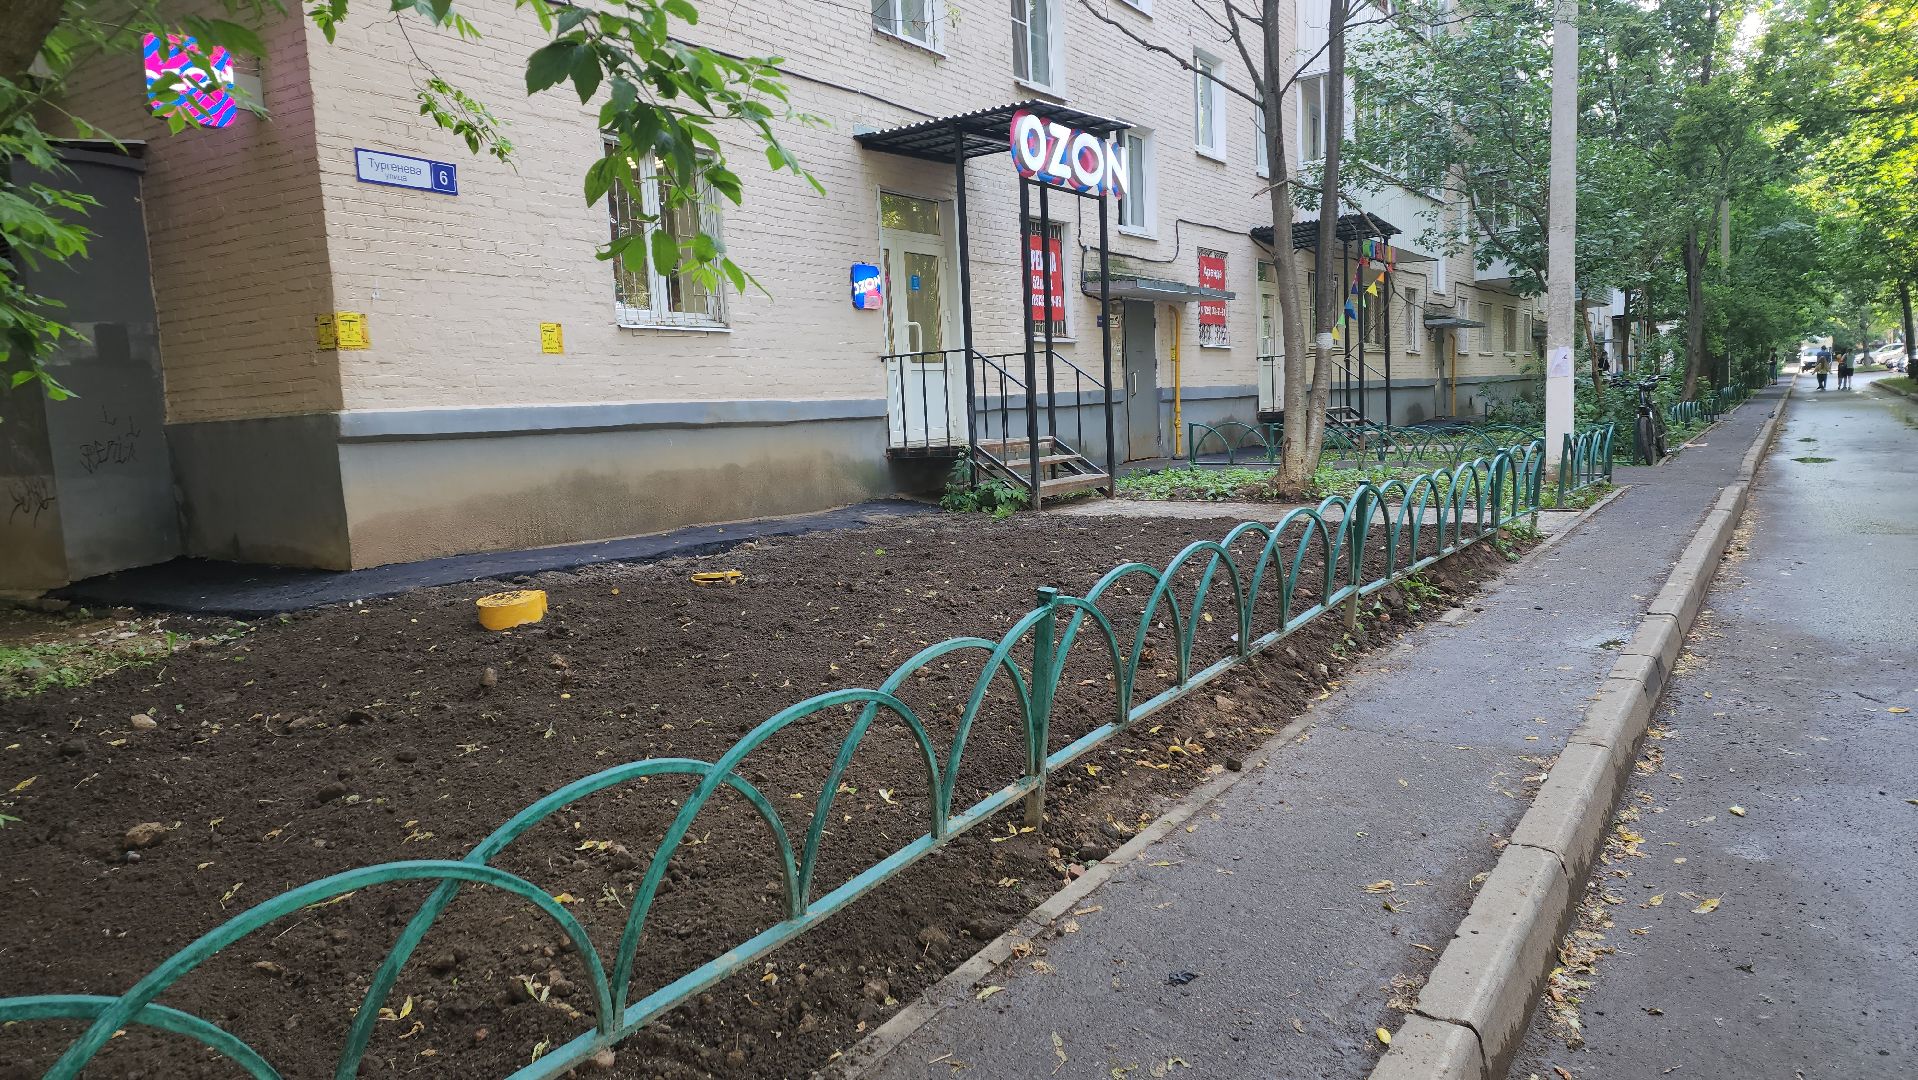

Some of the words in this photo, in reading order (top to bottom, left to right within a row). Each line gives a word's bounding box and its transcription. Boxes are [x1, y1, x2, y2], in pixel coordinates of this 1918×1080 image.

[1016, 112, 1128, 195] OZON
[367, 157, 422, 176] Тургенева
[385, 173, 408, 182] улица
[439, 170, 448, 186] 6
